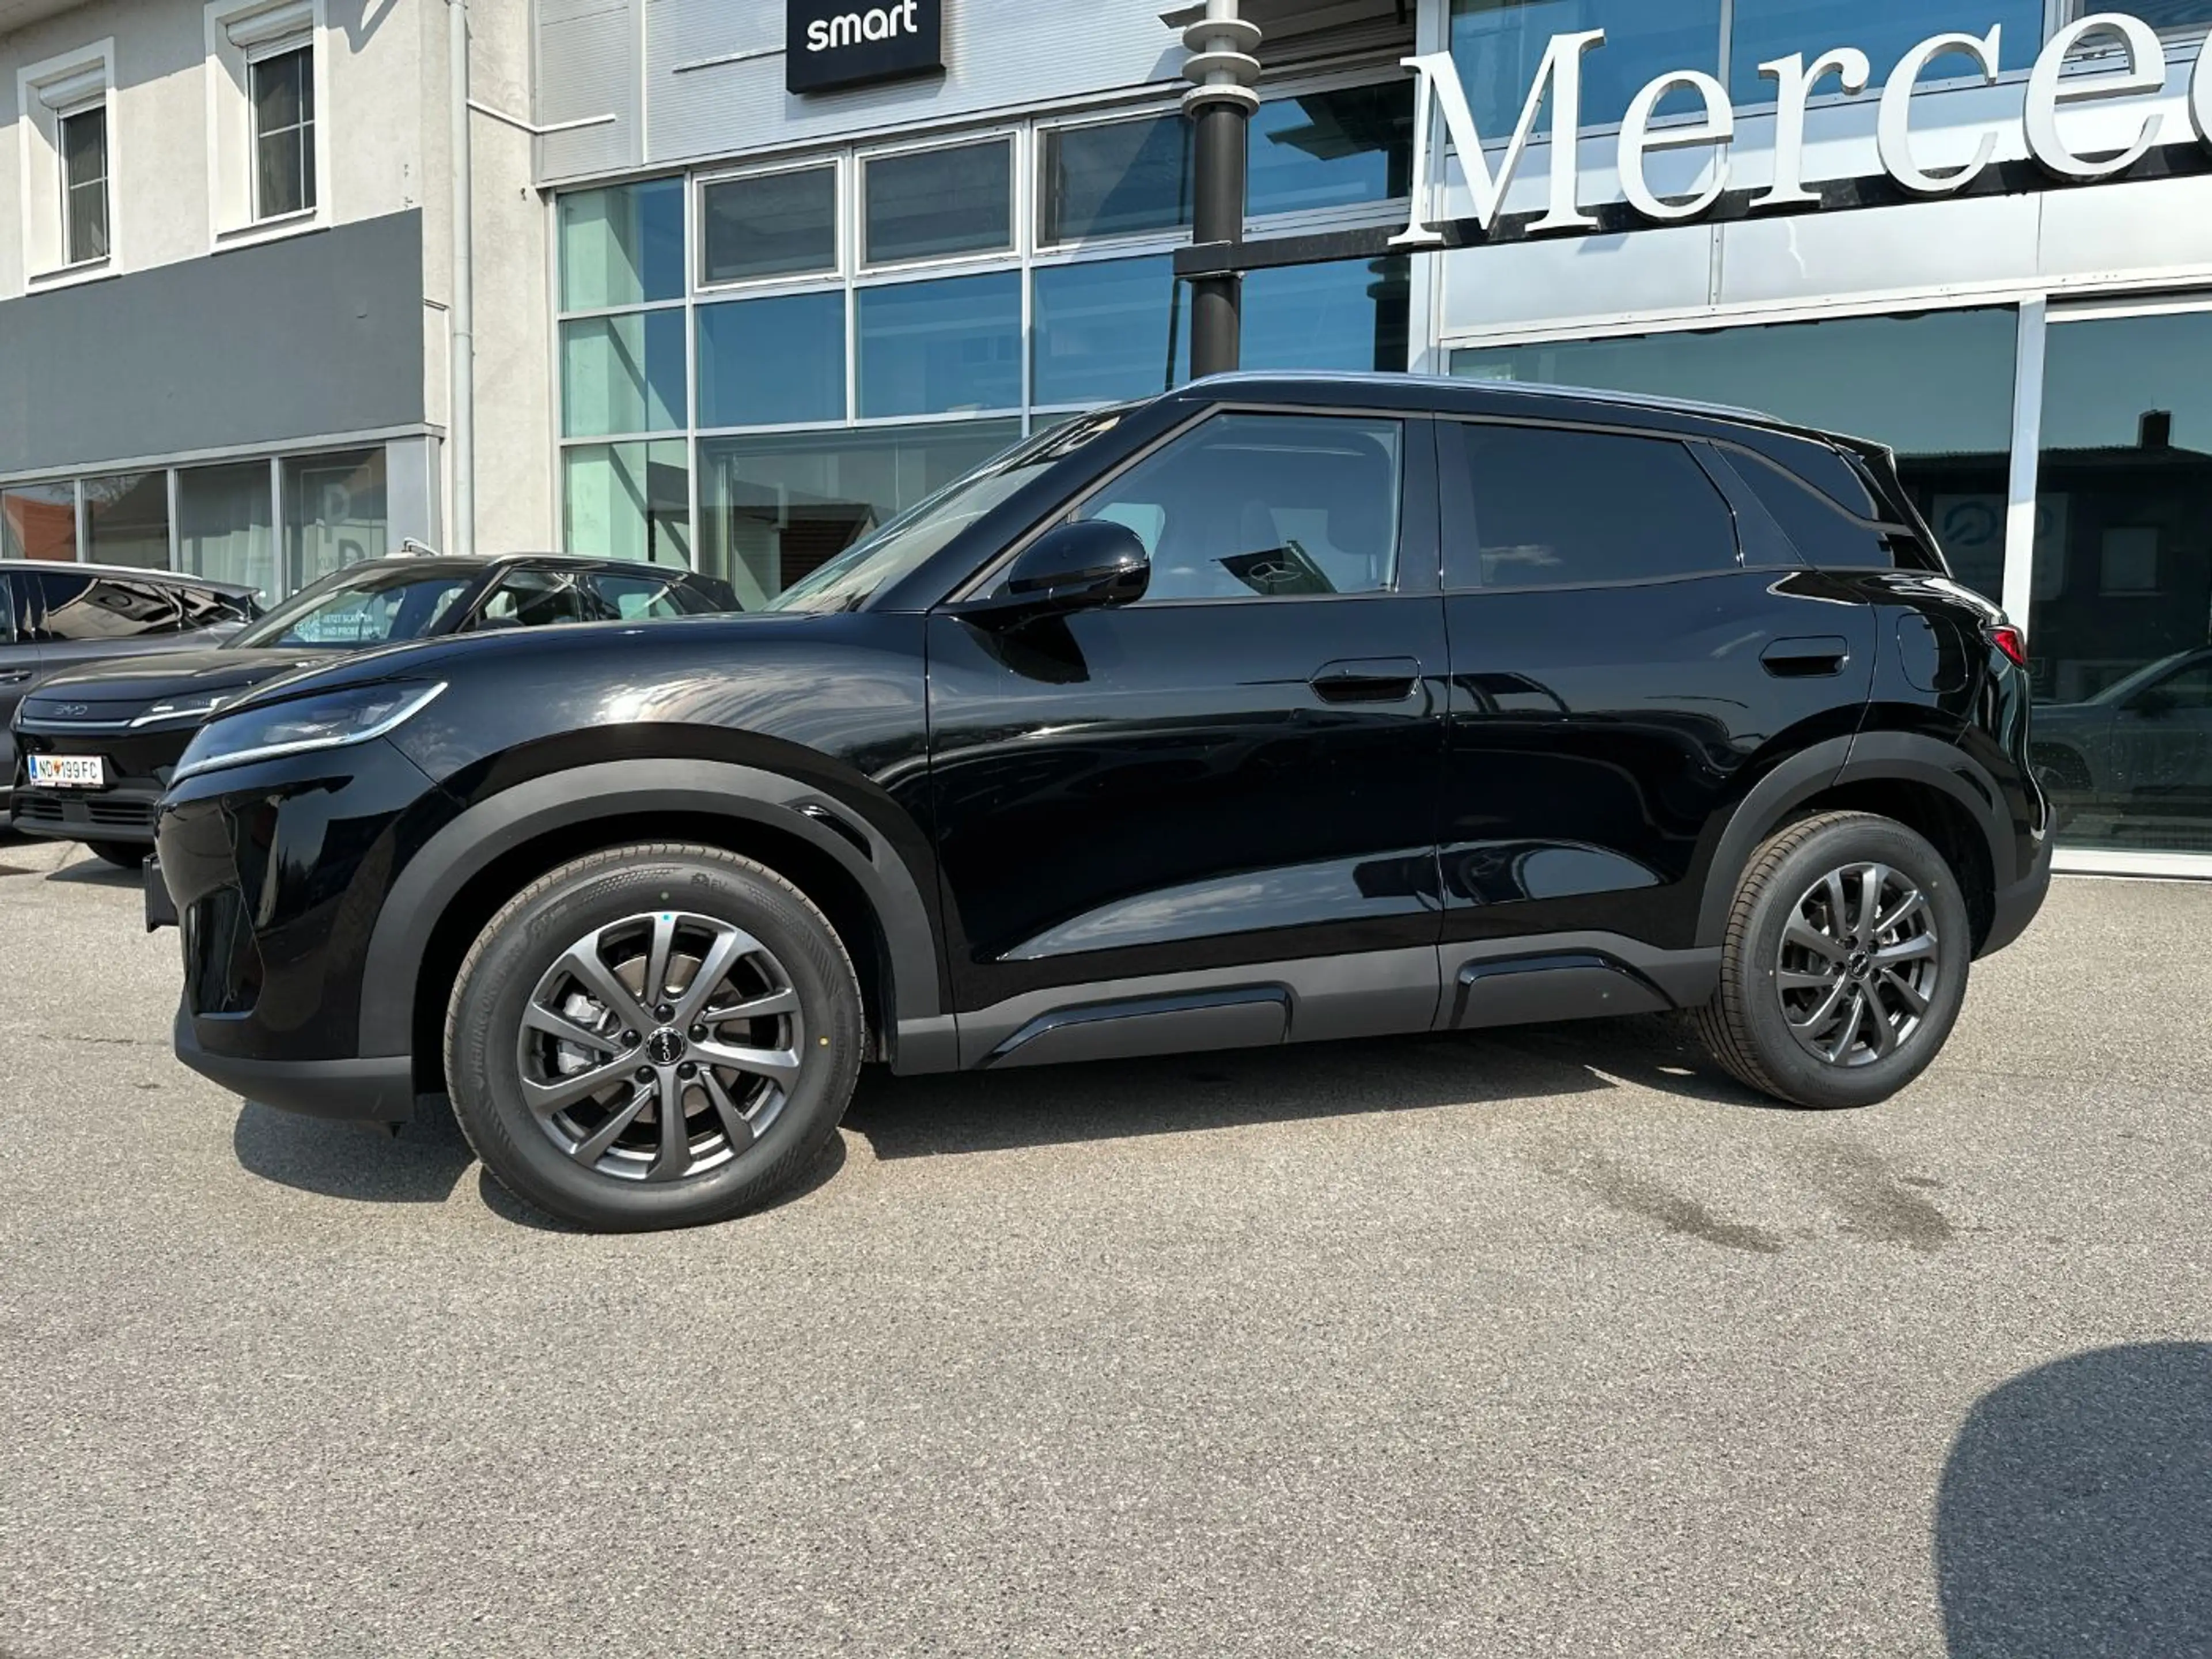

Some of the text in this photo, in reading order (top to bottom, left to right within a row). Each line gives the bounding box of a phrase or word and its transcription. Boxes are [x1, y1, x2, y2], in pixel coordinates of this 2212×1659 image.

[806, 0, 918, 52] smart
[1387, 12, 2212, 247] Merce
[39, 760, 53, 778] ND
